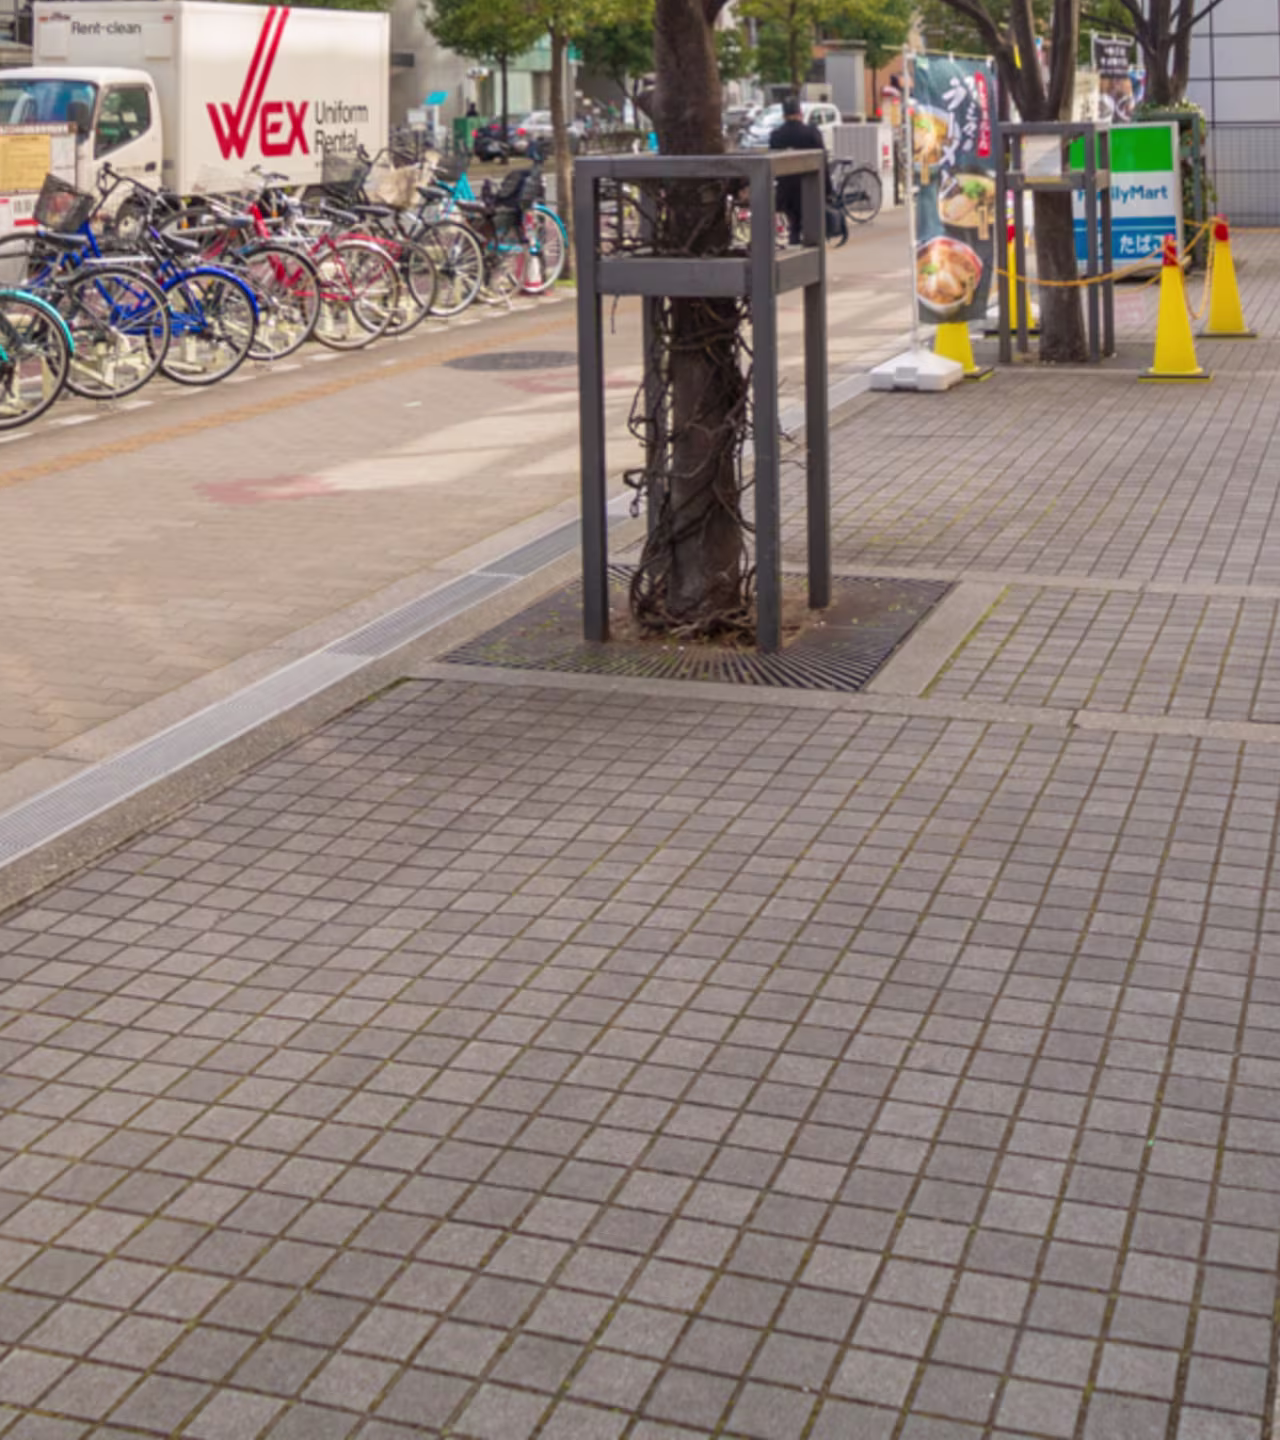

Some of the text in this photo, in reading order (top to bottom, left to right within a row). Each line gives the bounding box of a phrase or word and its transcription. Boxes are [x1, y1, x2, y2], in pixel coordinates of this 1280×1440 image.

[71, 21, 142, 35] Rent-clean
[315, 100, 369, 125] Uniform
[314, 128, 358, 154] Rental
[938, 76, 968, 200] ラーメン
